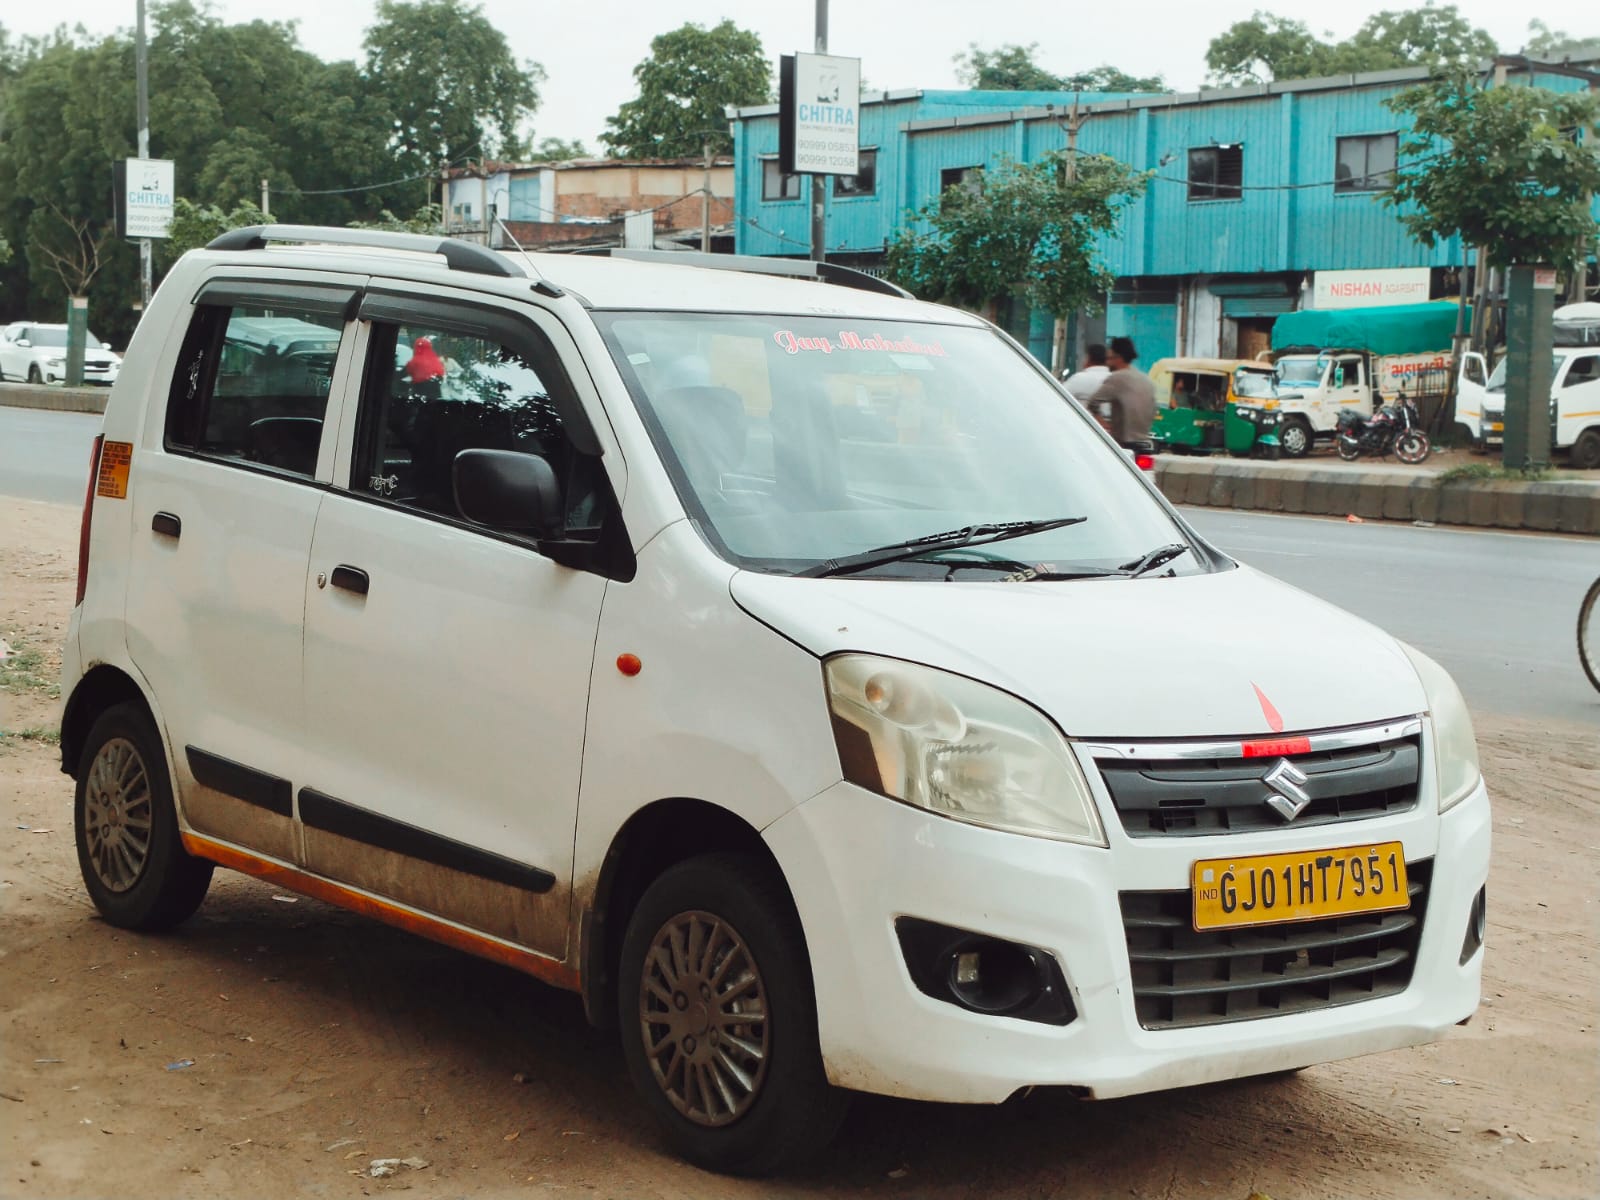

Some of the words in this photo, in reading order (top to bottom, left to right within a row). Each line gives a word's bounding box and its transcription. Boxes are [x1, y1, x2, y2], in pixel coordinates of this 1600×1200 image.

[799, 104, 854, 125] CHITRA
[128, 191, 170, 205] CHITRA
[1330, 282, 1382, 297] NISHAN
[774, 329, 832, 354] Jay
[1220, 853, 1399, 913] GJ01HT7951
[1200, 888, 1218, 900] IND
